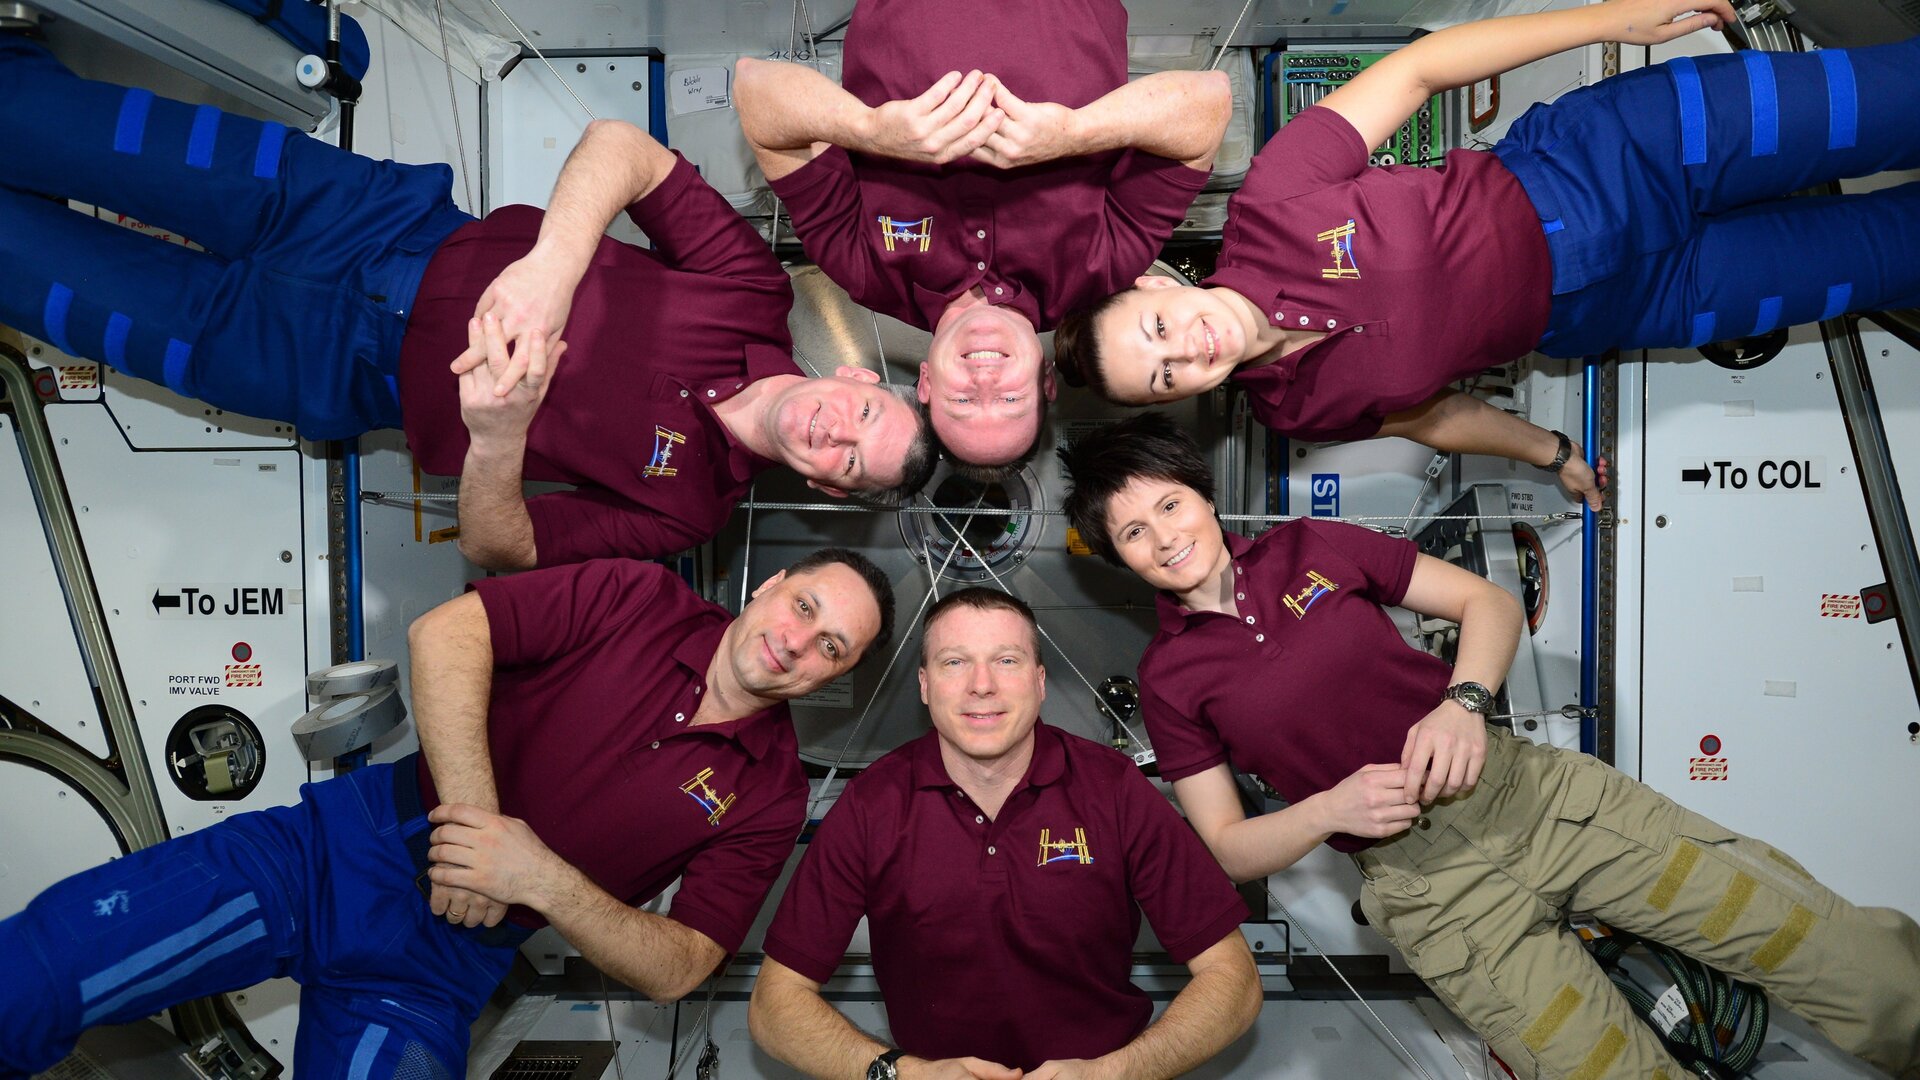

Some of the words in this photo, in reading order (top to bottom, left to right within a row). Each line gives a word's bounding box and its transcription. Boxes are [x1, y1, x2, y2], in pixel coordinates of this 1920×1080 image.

[1713, 461, 1748, 489] To
[1757, 460, 1821, 489] COL
[1313, 479, 1337, 516] ST
[1511, 492, 1520, 500] FWD
[1521, 493, 1533, 501] STBD
[1520, 503, 1533, 511] VALVE
[181, 587, 215, 615] To
[224, 587, 284, 615] JEM
[168, 675, 195, 684] PORT
[198, 675, 220, 684] FWD
[169, 686, 187, 695] IMV
[188, 687, 220, 695] VALVE
